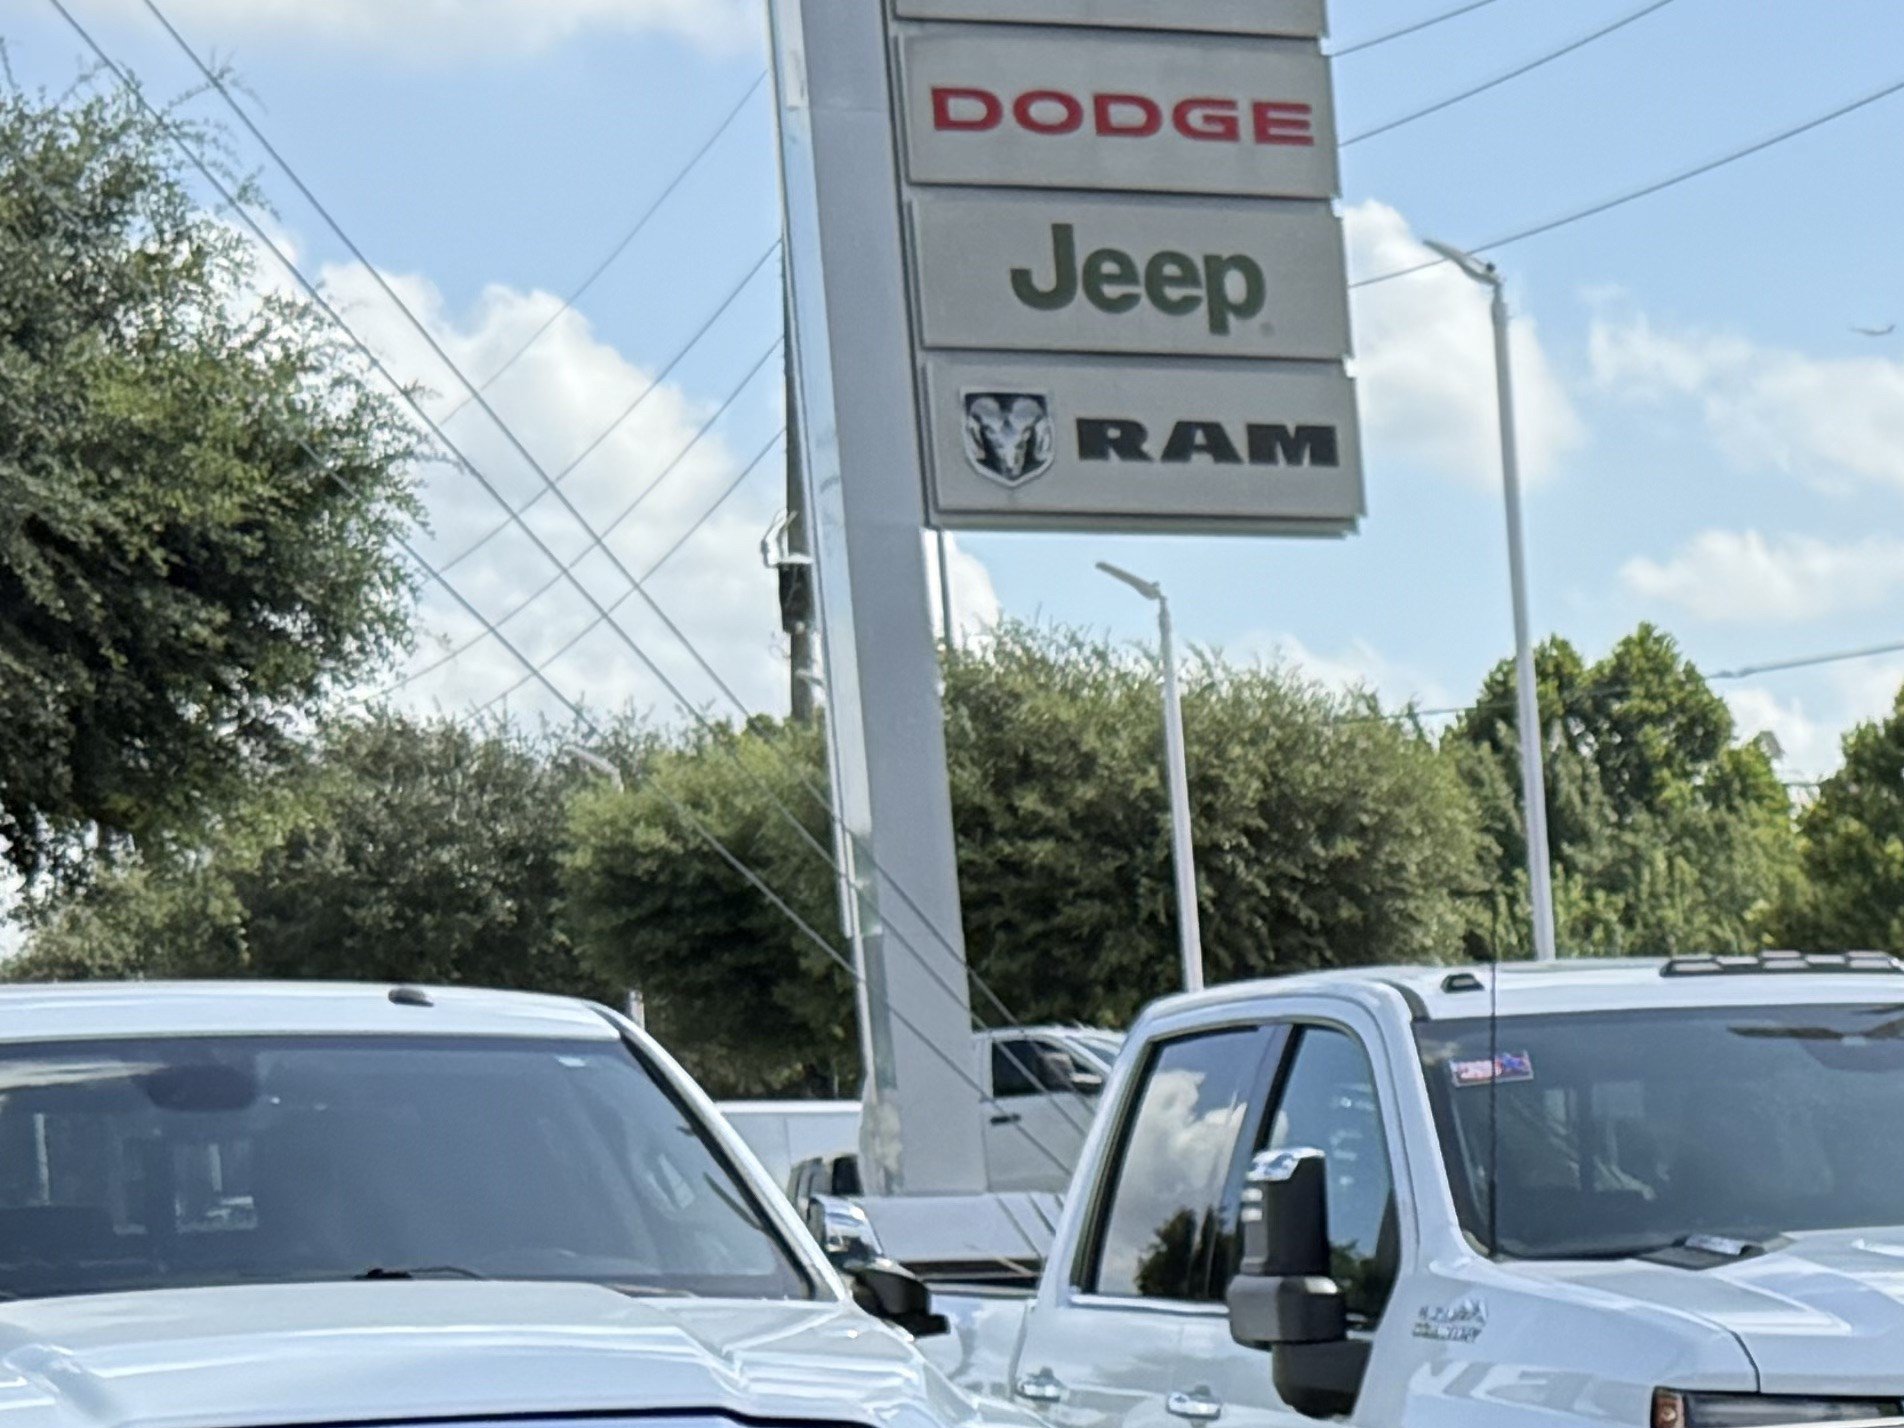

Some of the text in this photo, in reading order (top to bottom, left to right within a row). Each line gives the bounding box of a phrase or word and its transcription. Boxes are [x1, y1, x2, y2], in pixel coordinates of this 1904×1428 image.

[929, 86, 1315, 146] DODGE
[1009, 222, 1267, 335] Jeep
[1074, 416, 1339, 468] RAM
